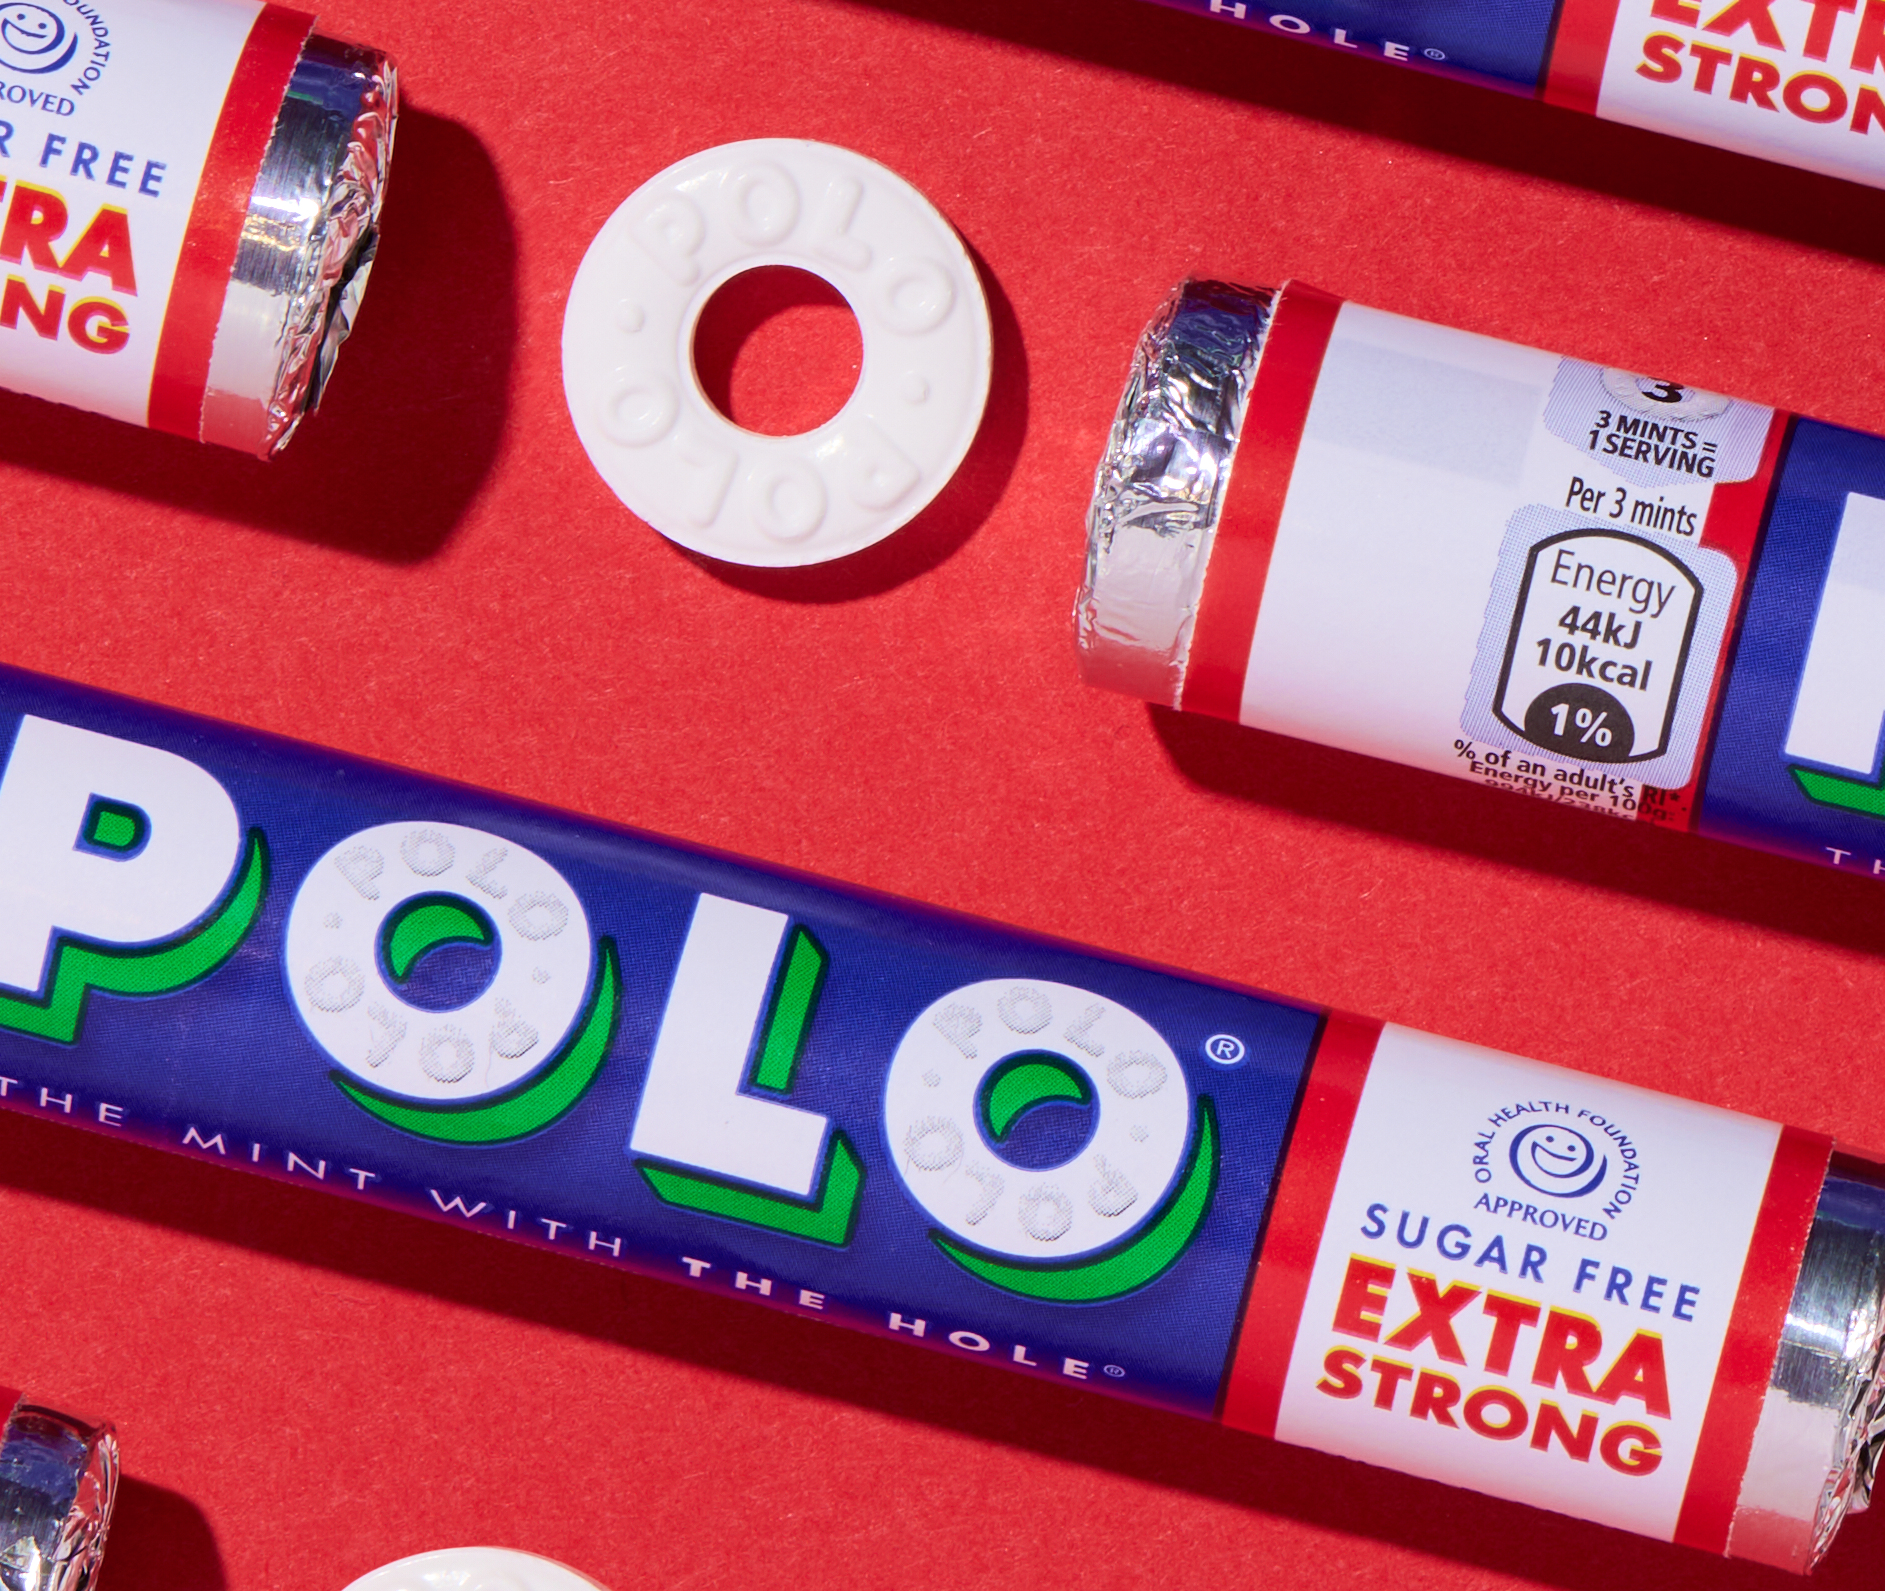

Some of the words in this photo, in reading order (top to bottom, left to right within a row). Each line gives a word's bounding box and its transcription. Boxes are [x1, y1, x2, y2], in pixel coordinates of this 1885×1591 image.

[40, 133, 166, 197] FREE
[1550, 549, 1676, 619] Energy
[1558, 605, 1642, 650] 44kJ
[1537, 637, 1653, 691] 10kcal
[1551, 703, 1612, 747] 1%
[1472, 1131, 1496, 1184] ORAL
[1488, 1100, 1570, 1127] HEALTH
[1577, 1109, 1640, 1219] FOUNDATION
[1474, 1192, 1608, 1241] APPROVED
[1361, 1203, 1548, 1282] SUGAR
[1574, 1258, 1700, 1321] FREE
[1332, 1252, 1671, 1418] EXTRA
[1316, 1345, 1662, 1476] STRONG
